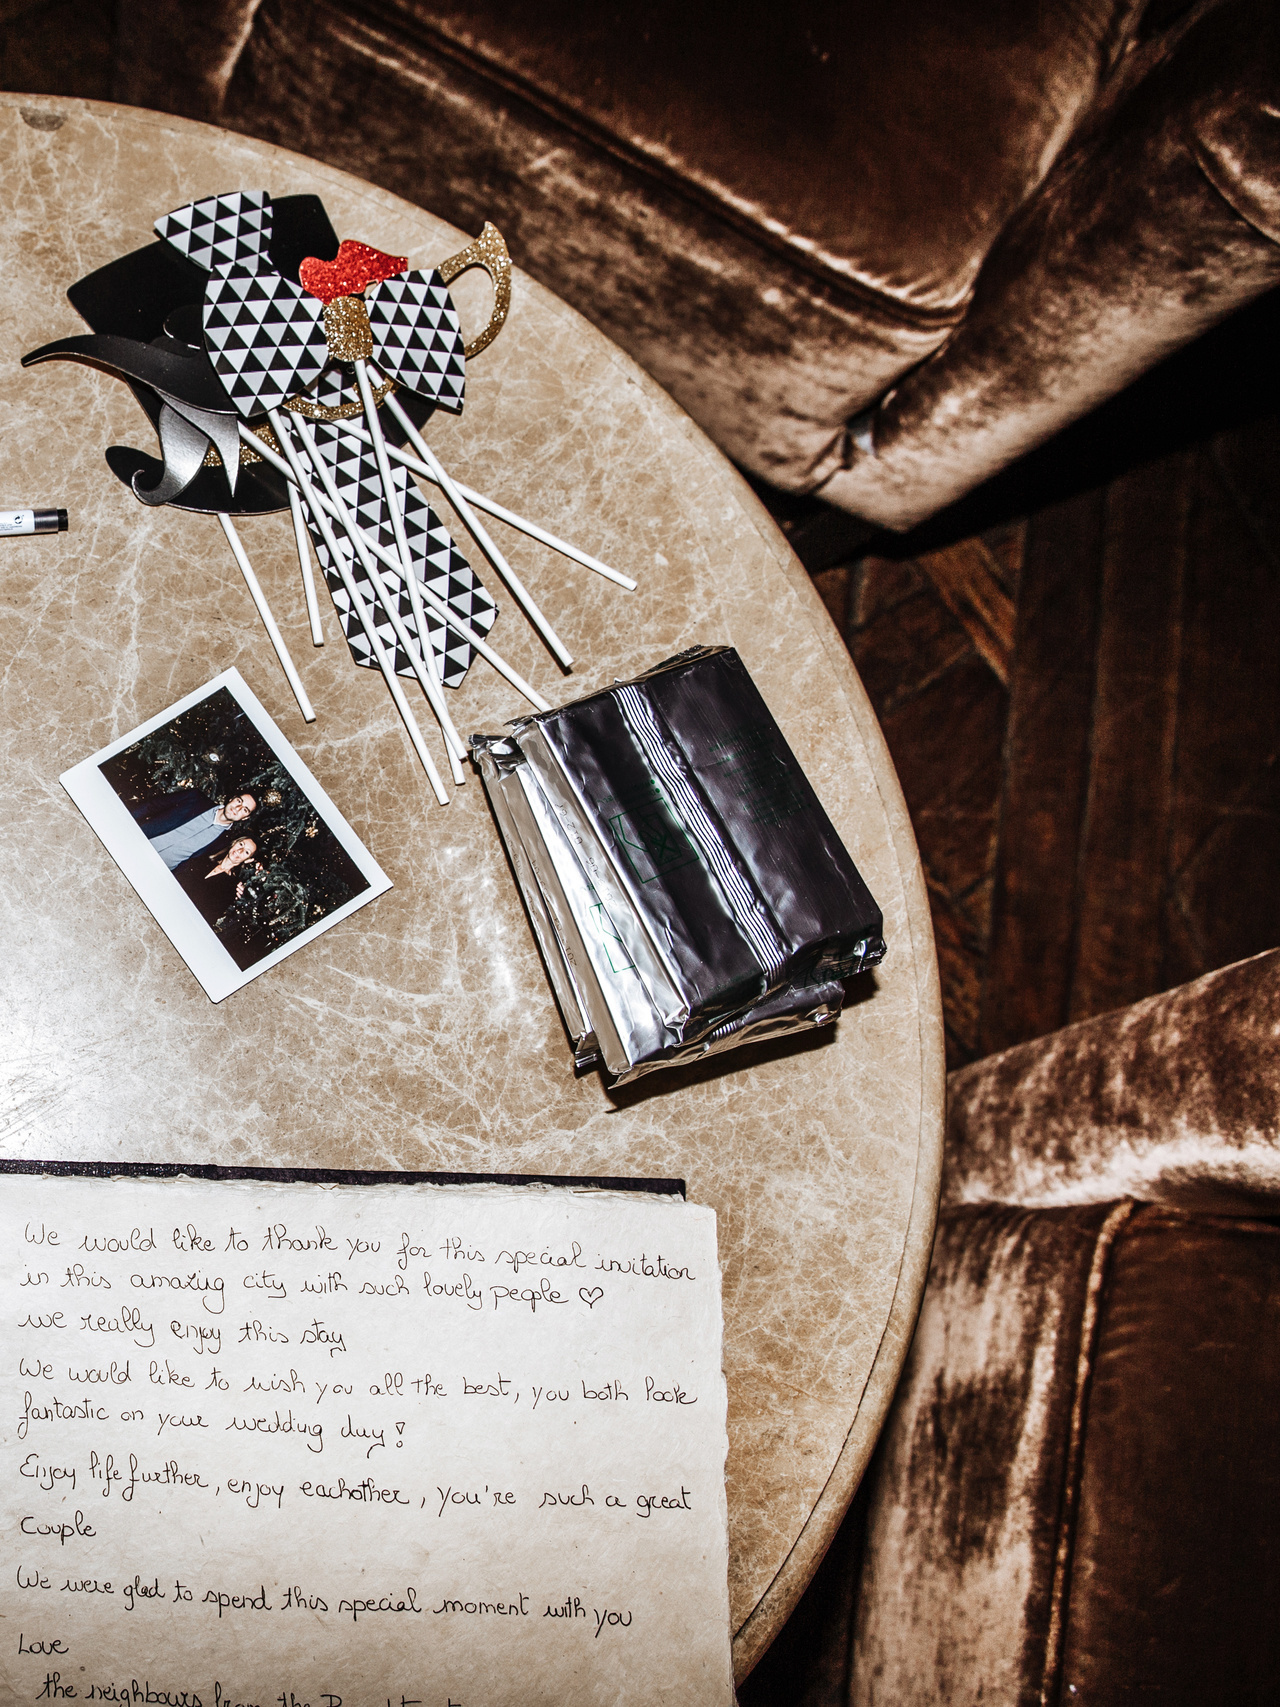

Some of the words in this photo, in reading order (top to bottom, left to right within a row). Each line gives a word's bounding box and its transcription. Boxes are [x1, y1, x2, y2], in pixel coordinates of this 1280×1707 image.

[25, 1224, 60, 1245] We
[78, 1228, 157, 1252] would
[172, 1224, 215, 1251] like
[225, 1227, 248, 1251] to
[262, 1224, 338, 1251] thank
[346, 1239, 380, 1260] you
[397, 1232, 432, 1270] for
[439, 1237, 485, 1262] this
[495, 1241, 586, 1273] special
[595, 1253, 696, 1280] invitation
[20, 1263, 49, 1286] in
[60, 1264, 111, 1289] this
[130, 1273, 224, 1314] amazing
[243, 1270, 286, 1298] city
[301, 1272, 348, 1293] with
[359, 1275, 409, 1296] such
[423, 1271, 482, 1310] lovely
[490, 1278, 569, 1313] people
[18, 1312, 67, 1328] we
[80, 1306, 155, 1348] really
[170, 1320, 221, 1354] enjoy
[238, 1320, 289, 1343] this
[300, 1319, 346, 1358] stay
[20, 1358, 54, 1380] We
[69, 1360, 131, 1384] would
[149, 1359, 195, 1387] like
[205, 1367, 229, 1390] to
[243, 1369, 305, 1393] wish
[316, 1382, 352, 1404] you
[370, 1372, 403, 1396] all
[411, 1374, 447, 1396] the
[463, 1372, 519, 1404] best,
[532, 1387, 569, 1409] you
[582, 1380, 628, 1400] both
[17, 1391, 109, 1439] fantastic
[121, 1410, 144, 1421] on
[158, 1414, 209, 1436] your
[225, 1410, 323, 1453] wedding
[20, 1453, 76, 1490] Enjoy
[89, 1451, 122, 1497] life
[228, 1479, 284, 1509] enjoy
[437, 1485, 516, 1517] you're
[539, 1484, 594, 1508] such
[605, 1496, 627, 1507] a
[636, 1486, 691, 1518] great
[17, 1565, 51, 1589] We
[60, 1580, 114, 1593] were
[123, 1575, 165, 1611] glad
[173, 1580, 193, 1603] to
[202, 1585, 272, 1618] spend
[281, 1586, 328, 1611] this
[339, 1587, 422, 1622] special
[433, 1592, 529, 1615] moment
[543, 1597, 586, 1618] with
[594, 1609, 632, 1638] you
[18, 1633, 69, 1655] Love
[35, 1672, 77, 1699] the
